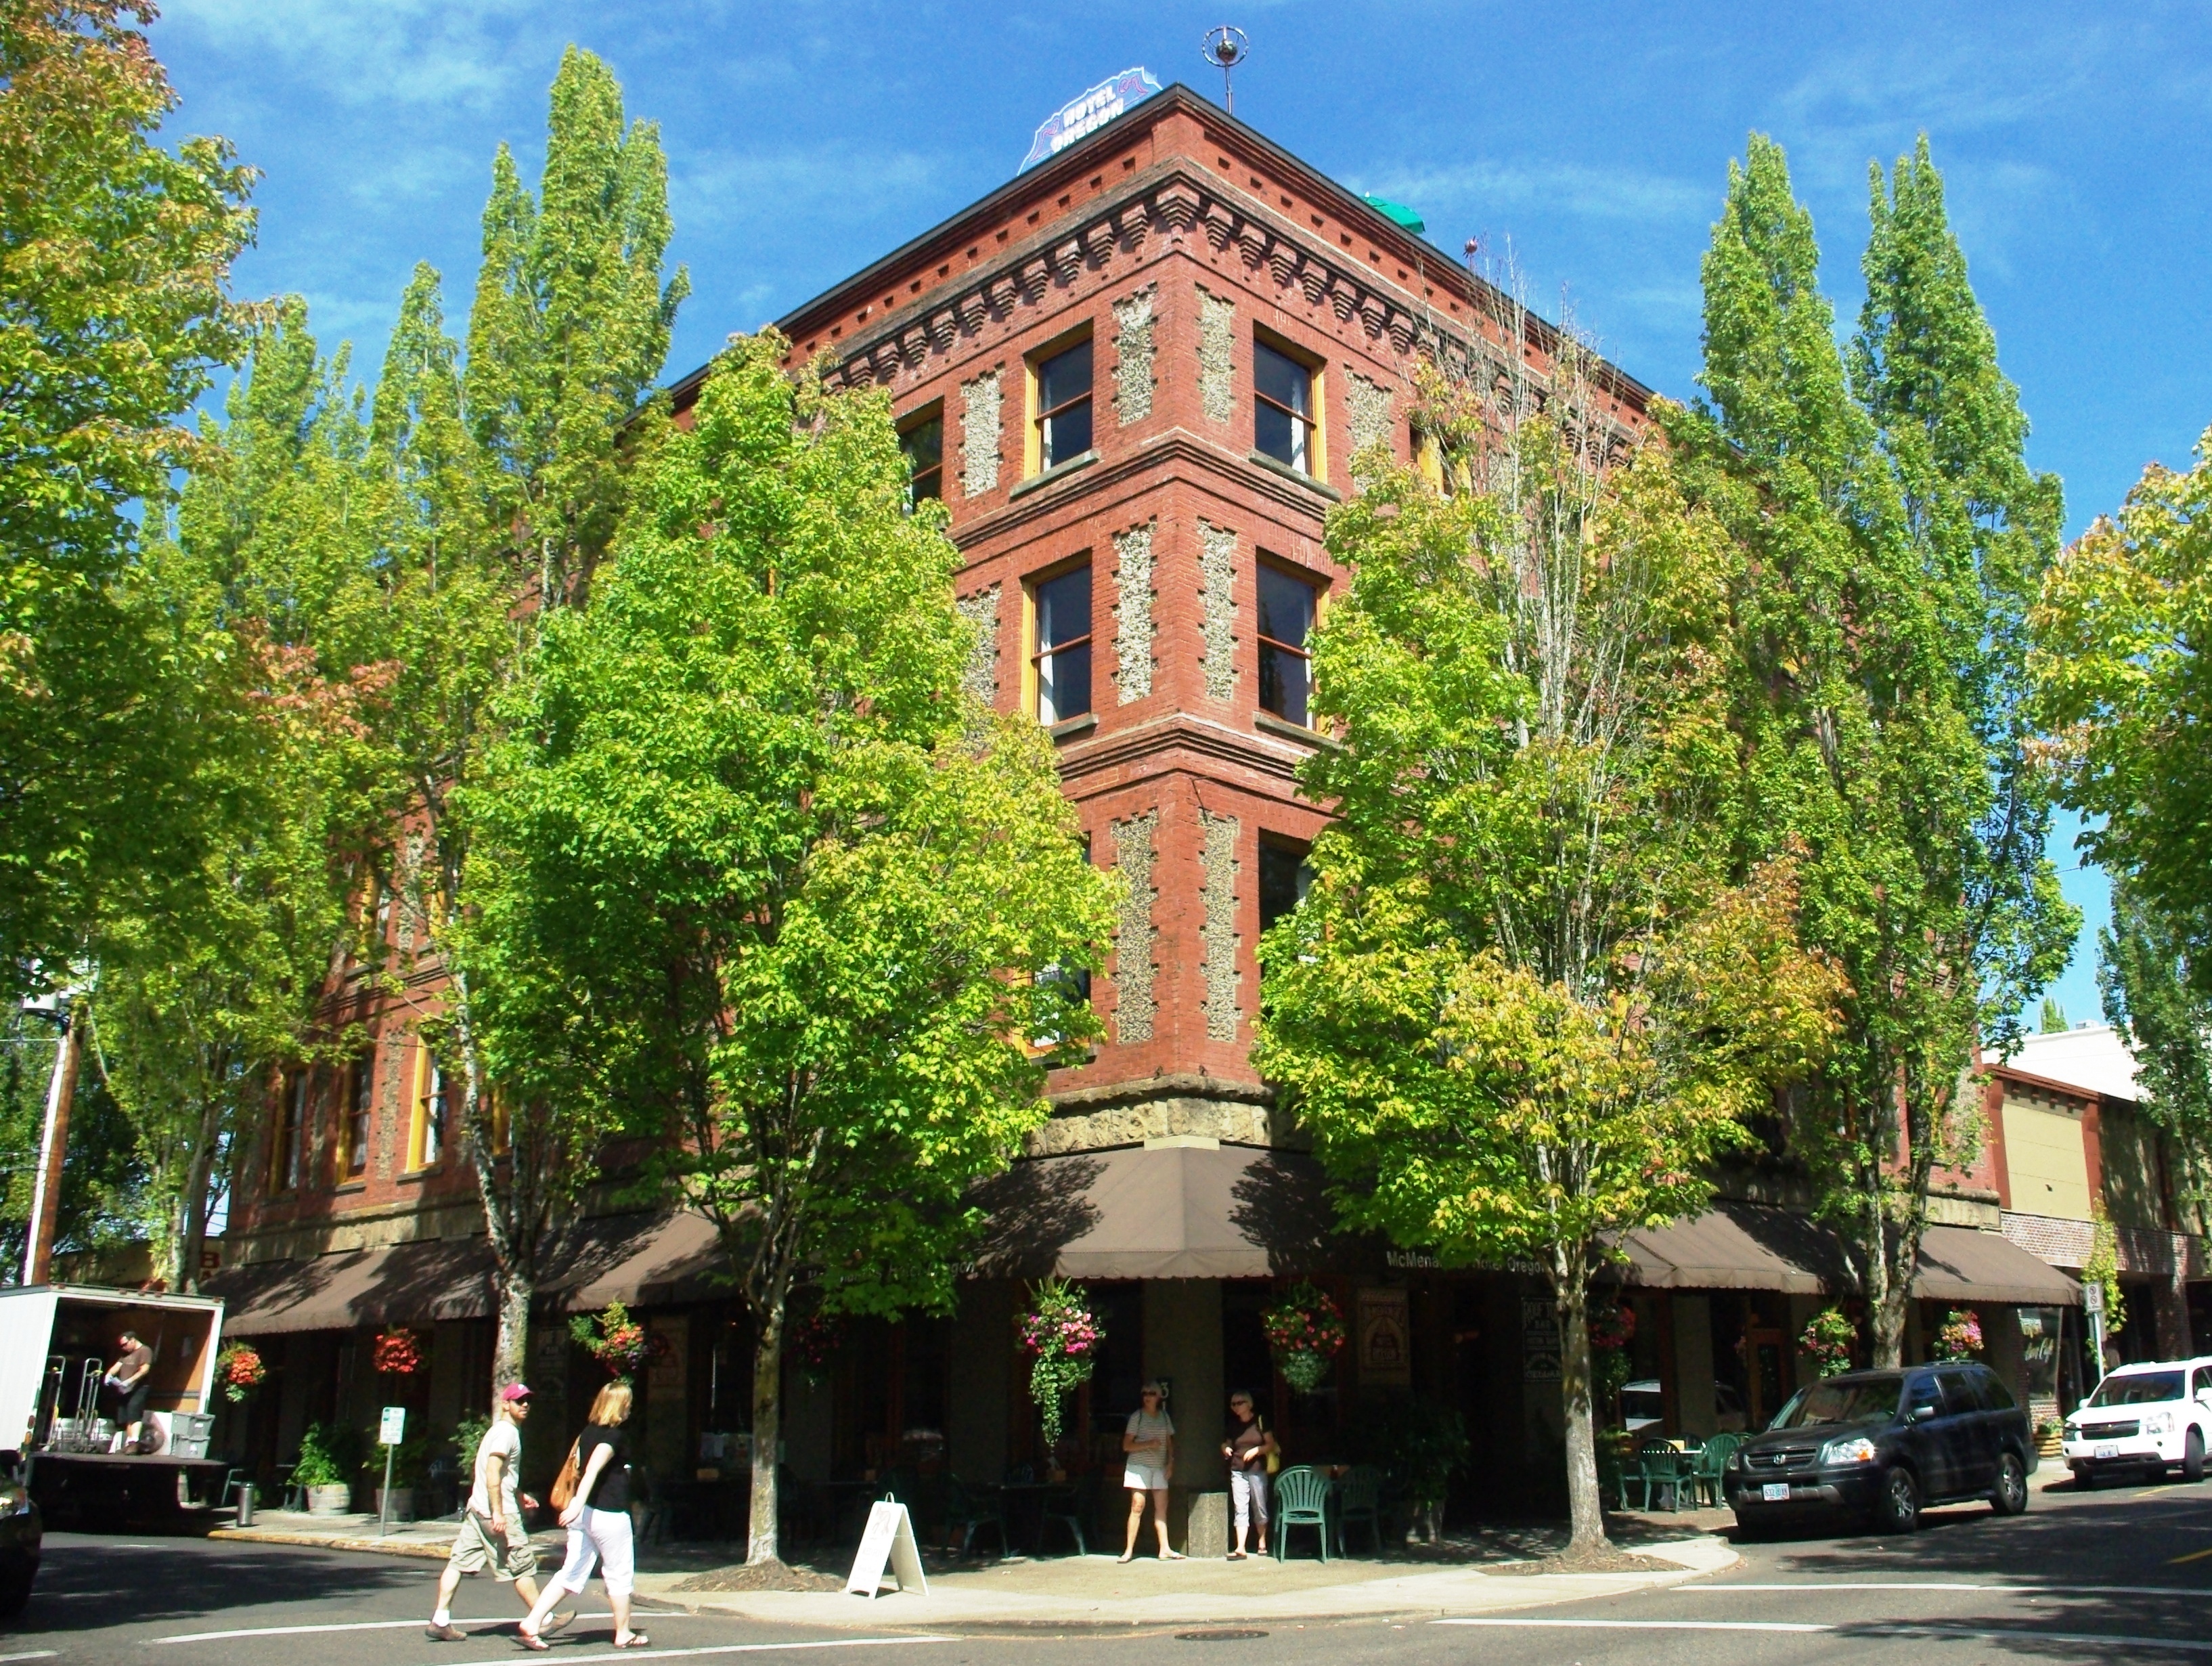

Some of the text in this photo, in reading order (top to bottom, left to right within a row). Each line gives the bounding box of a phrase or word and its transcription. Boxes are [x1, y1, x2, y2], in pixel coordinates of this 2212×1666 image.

[1050, 98, 1124, 153] OREGON
[1063, 85, 1116, 127] HOTEL
[1507, 1256, 1546, 1276] Orego
